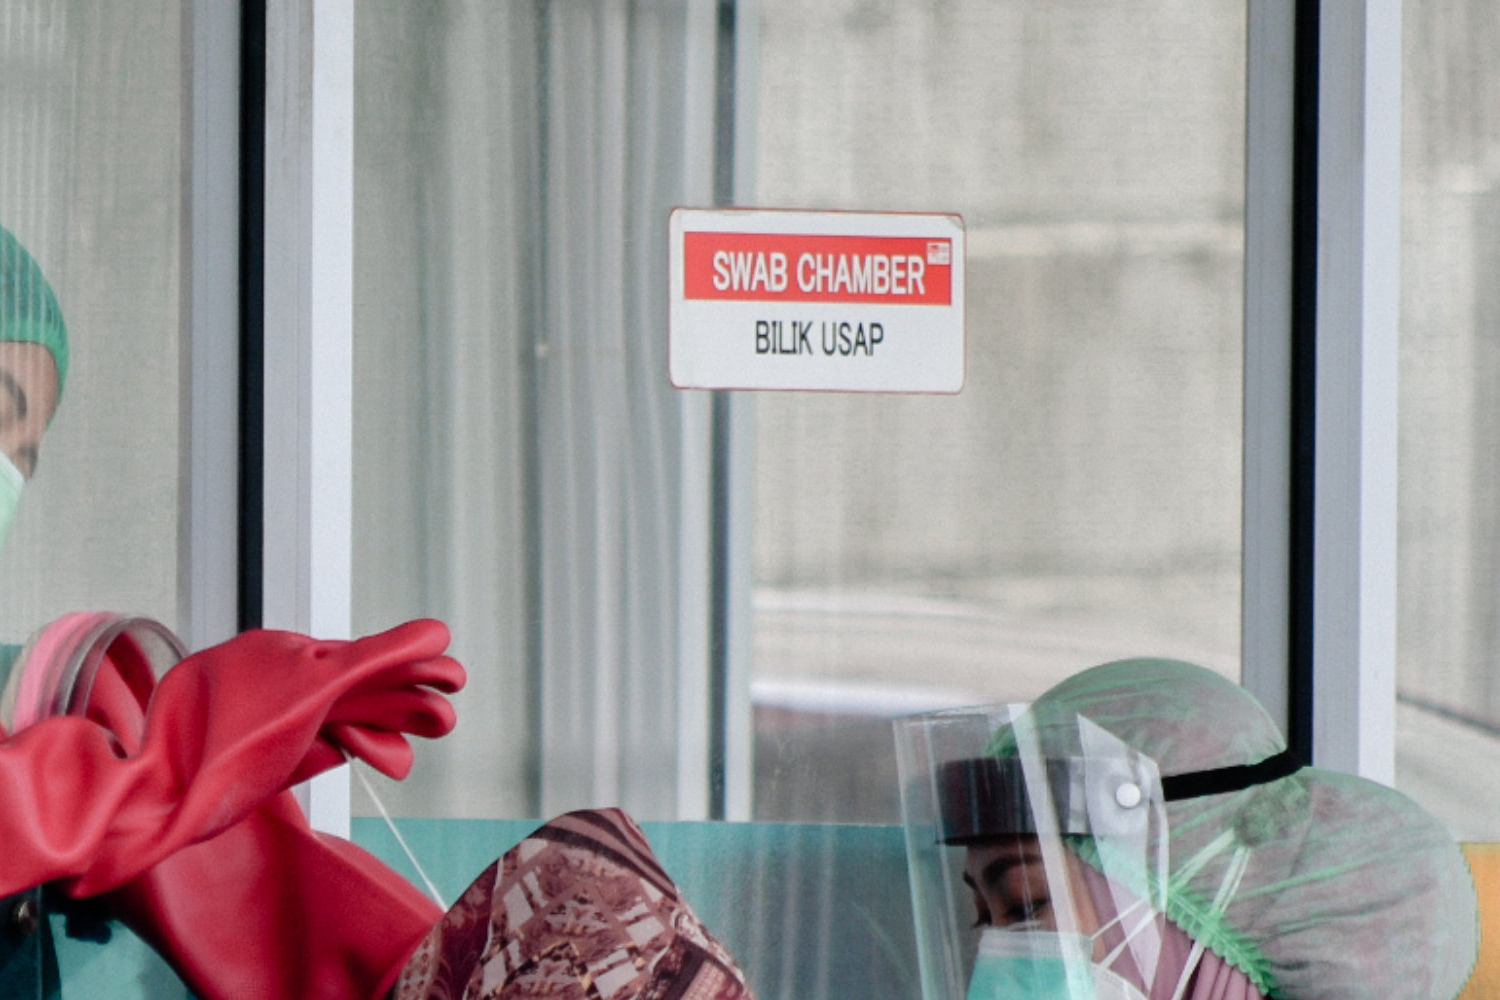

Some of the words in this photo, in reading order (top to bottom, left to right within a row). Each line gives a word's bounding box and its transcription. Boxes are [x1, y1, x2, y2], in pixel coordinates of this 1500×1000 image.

[712, 250, 788, 292] SWAB
[797, 252, 926, 295] CHAMBER
[755, 320, 814, 355] BILIK
[821, 322, 884, 356] USAP
